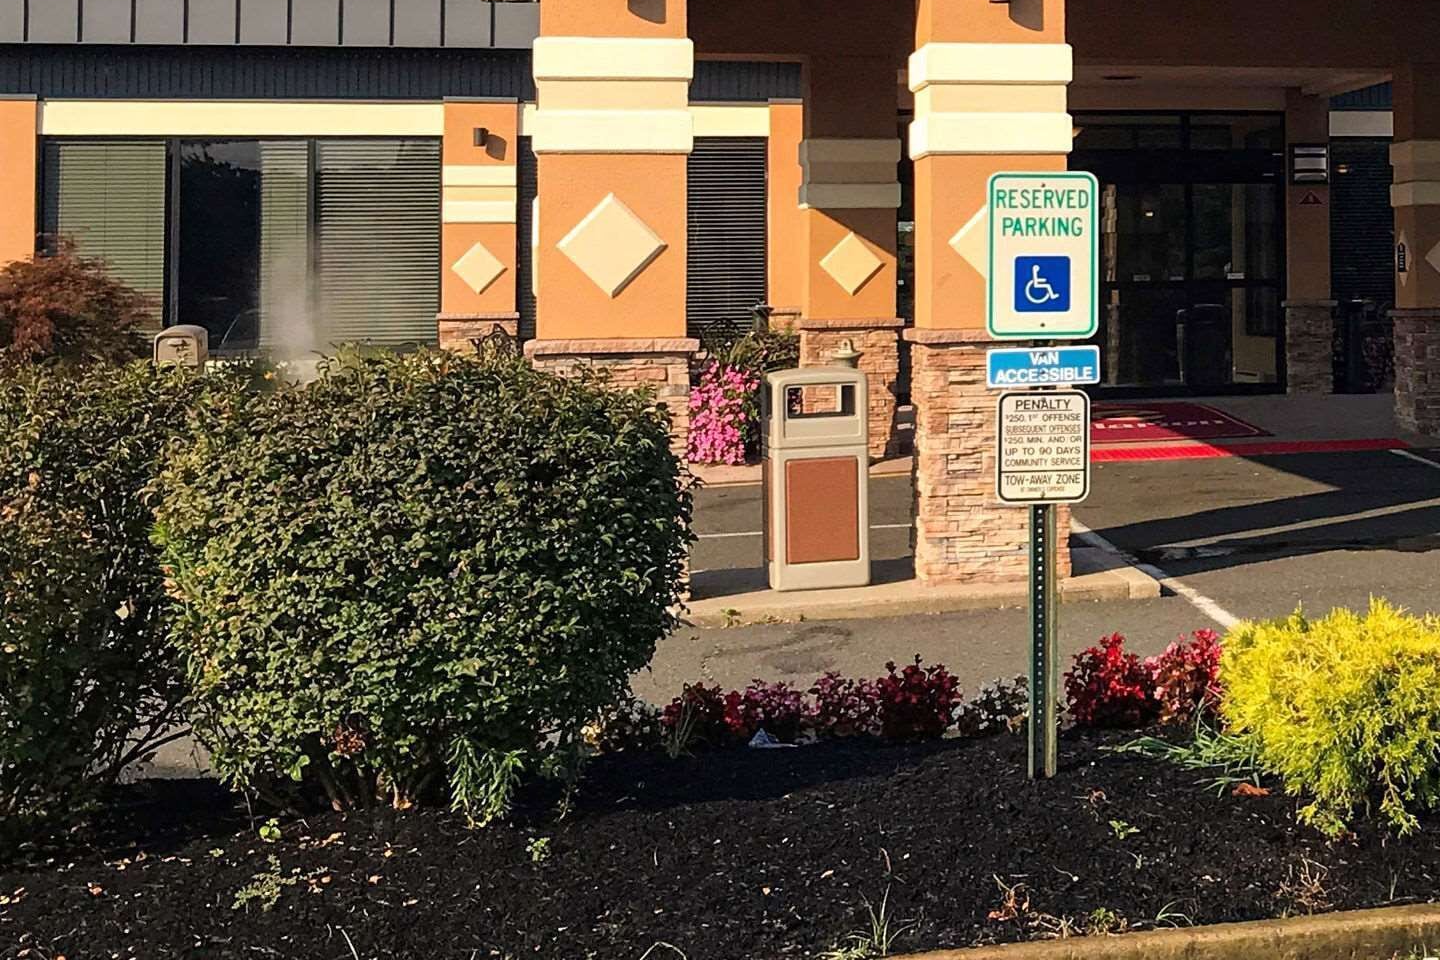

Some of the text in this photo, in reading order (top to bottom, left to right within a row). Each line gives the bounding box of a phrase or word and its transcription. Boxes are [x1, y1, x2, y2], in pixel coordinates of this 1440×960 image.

[996, 189, 1089, 209] RESERVED
[1002, 217, 1084, 237] PARKING
[1029, 351, 1060, 366] VAN
[995, 366, 1093, 384] ACCESSIBLE
[1015, 399, 1072, 411] PENALTY
[1041, 412, 1082, 422] OFFENSE
[1005, 424, 1082, 435] SUBSEQUENT OFFENSES
[1004, 445, 1081, 457] UP TO 90 DAYS
[1004, 456, 1082, 468] COMMUNITY SERVICE
[1005, 473, 1082, 486] TOW-AWAY ZONE
